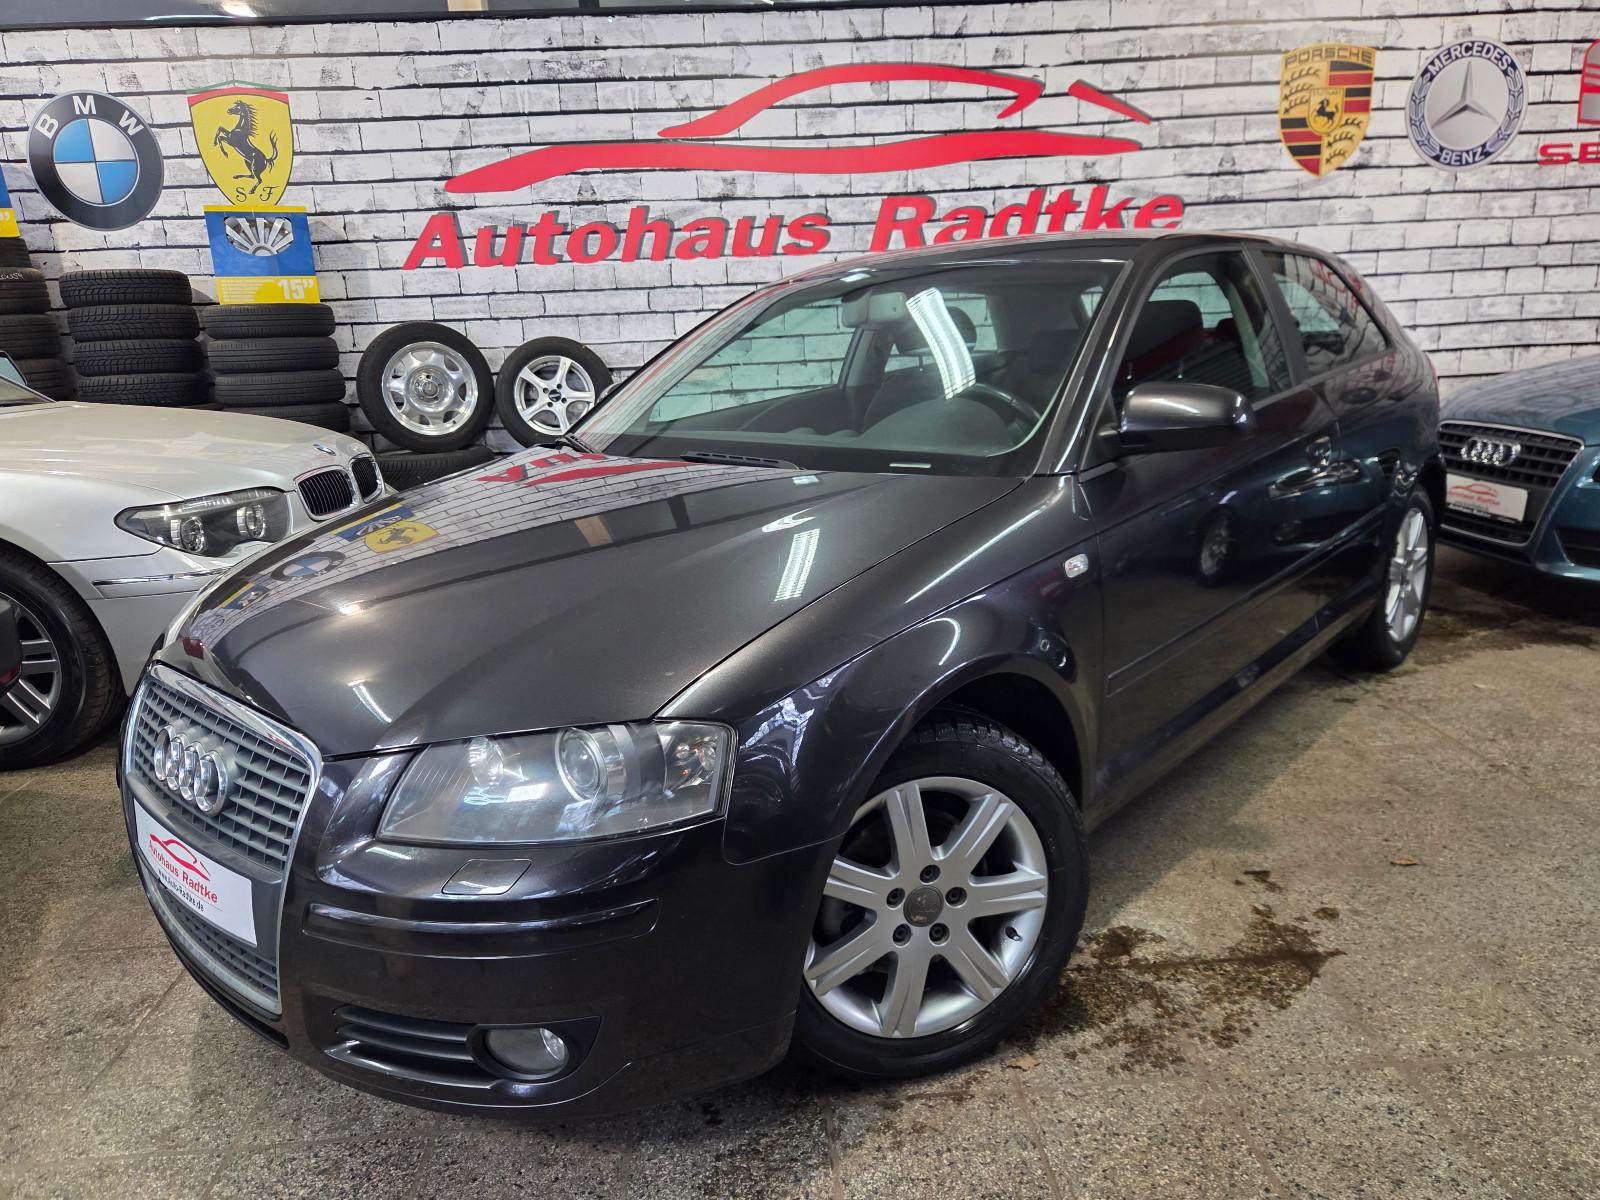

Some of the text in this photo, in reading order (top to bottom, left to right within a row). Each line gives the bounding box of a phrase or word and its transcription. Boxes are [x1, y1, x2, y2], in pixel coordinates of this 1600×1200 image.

[1285, 47, 1373, 70] PORSCHE
[1428, 41, 1512, 75] MERCEDES
[35, 95, 144, 139] BMW
[1440, 145, 1486, 166] BENZ
[402, 184, 1185, 270] Autohaus Radtke
[149, 839, 218, 903] Autohaus Radtke
